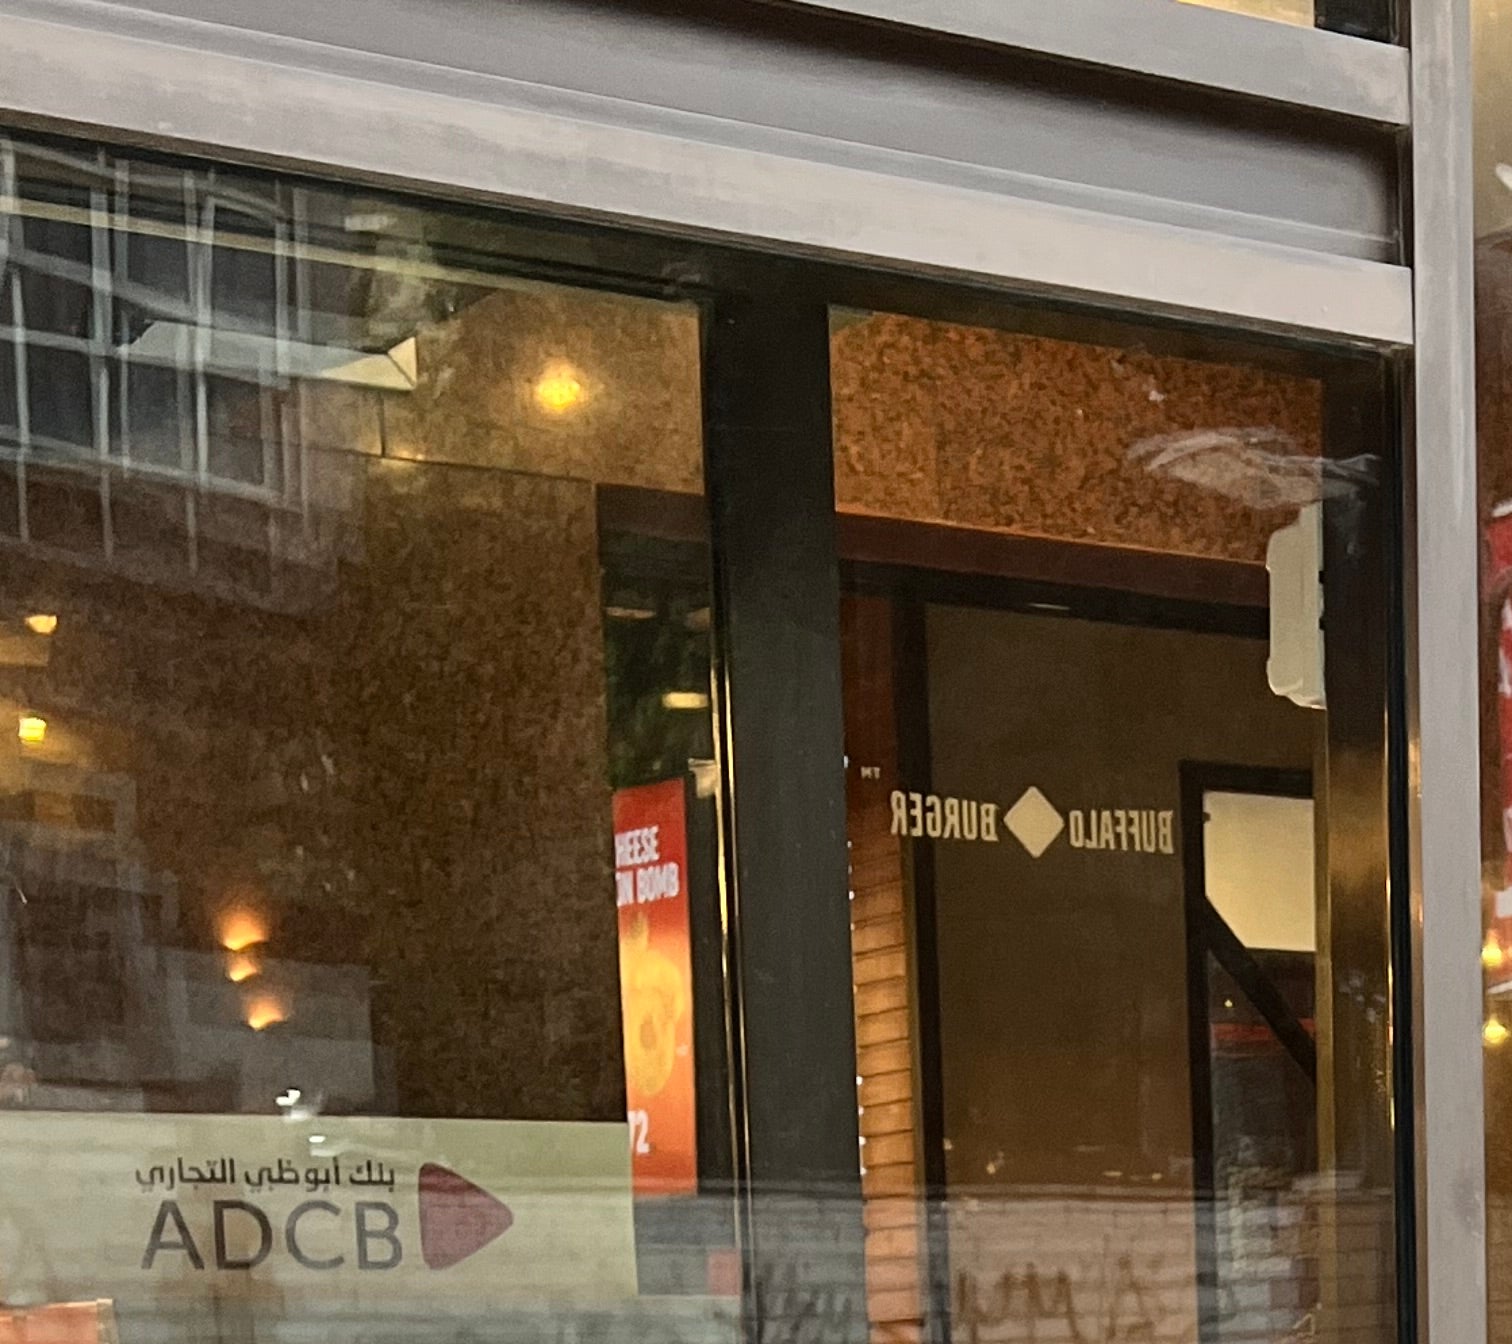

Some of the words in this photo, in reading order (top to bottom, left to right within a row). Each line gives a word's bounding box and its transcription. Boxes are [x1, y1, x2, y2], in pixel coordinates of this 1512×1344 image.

[614, 825, 660, 870] HEESE
[637, 861, 680, 904] BOMB
[349, 1160, 396, 1194] بنك
[140, 1199, 403, 1271] ADCB
